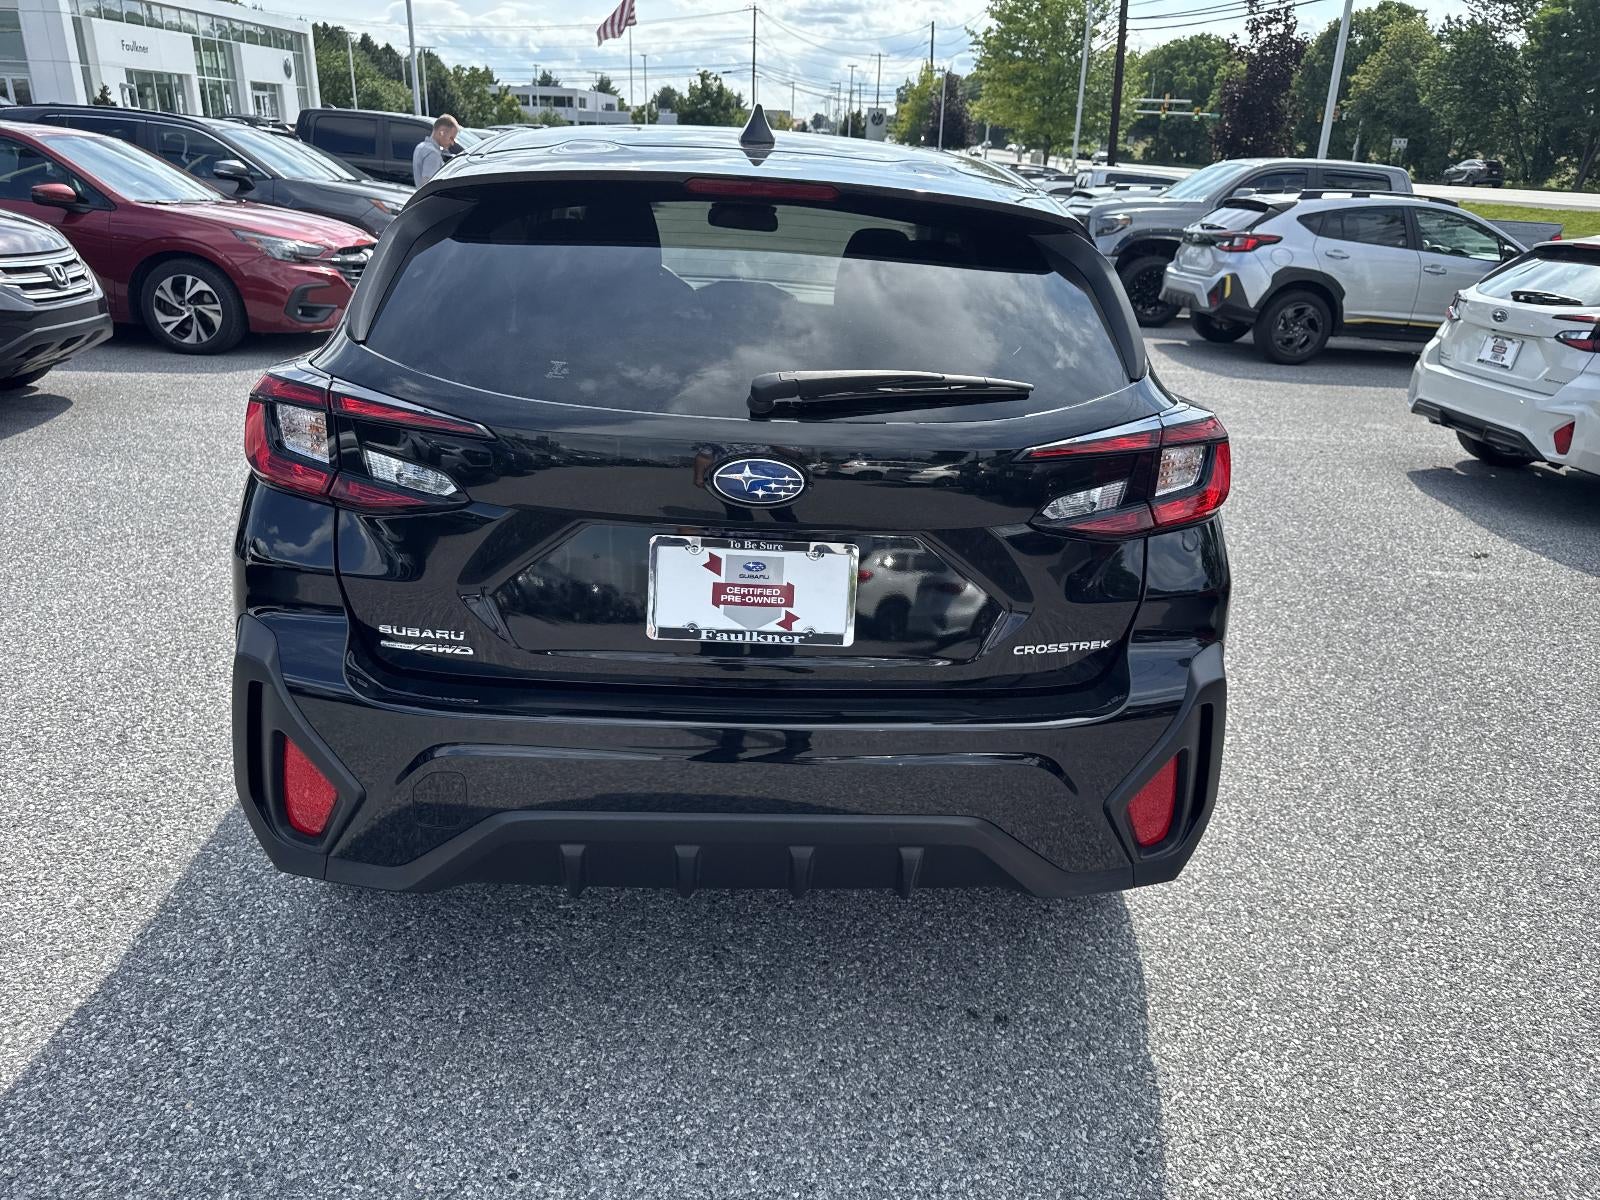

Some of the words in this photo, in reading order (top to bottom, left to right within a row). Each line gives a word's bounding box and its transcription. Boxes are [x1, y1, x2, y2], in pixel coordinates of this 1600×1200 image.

[121, 40, 149, 53] Faulkner
[728, 540, 740, 549] To
[744, 541, 757, 549] Be
[760, 542, 783, 551] Sure
[726, 586, 781, 596] CERTIFIED
[720, 595, 786, 604] PRE-OWNED
[379, 624, 465, 640] SUBARU
[700, 629, 805, 644] Faulkner
[415, 643, 474, 655] AWD
[1013, 639, 1112, 655] CROSSTREK
